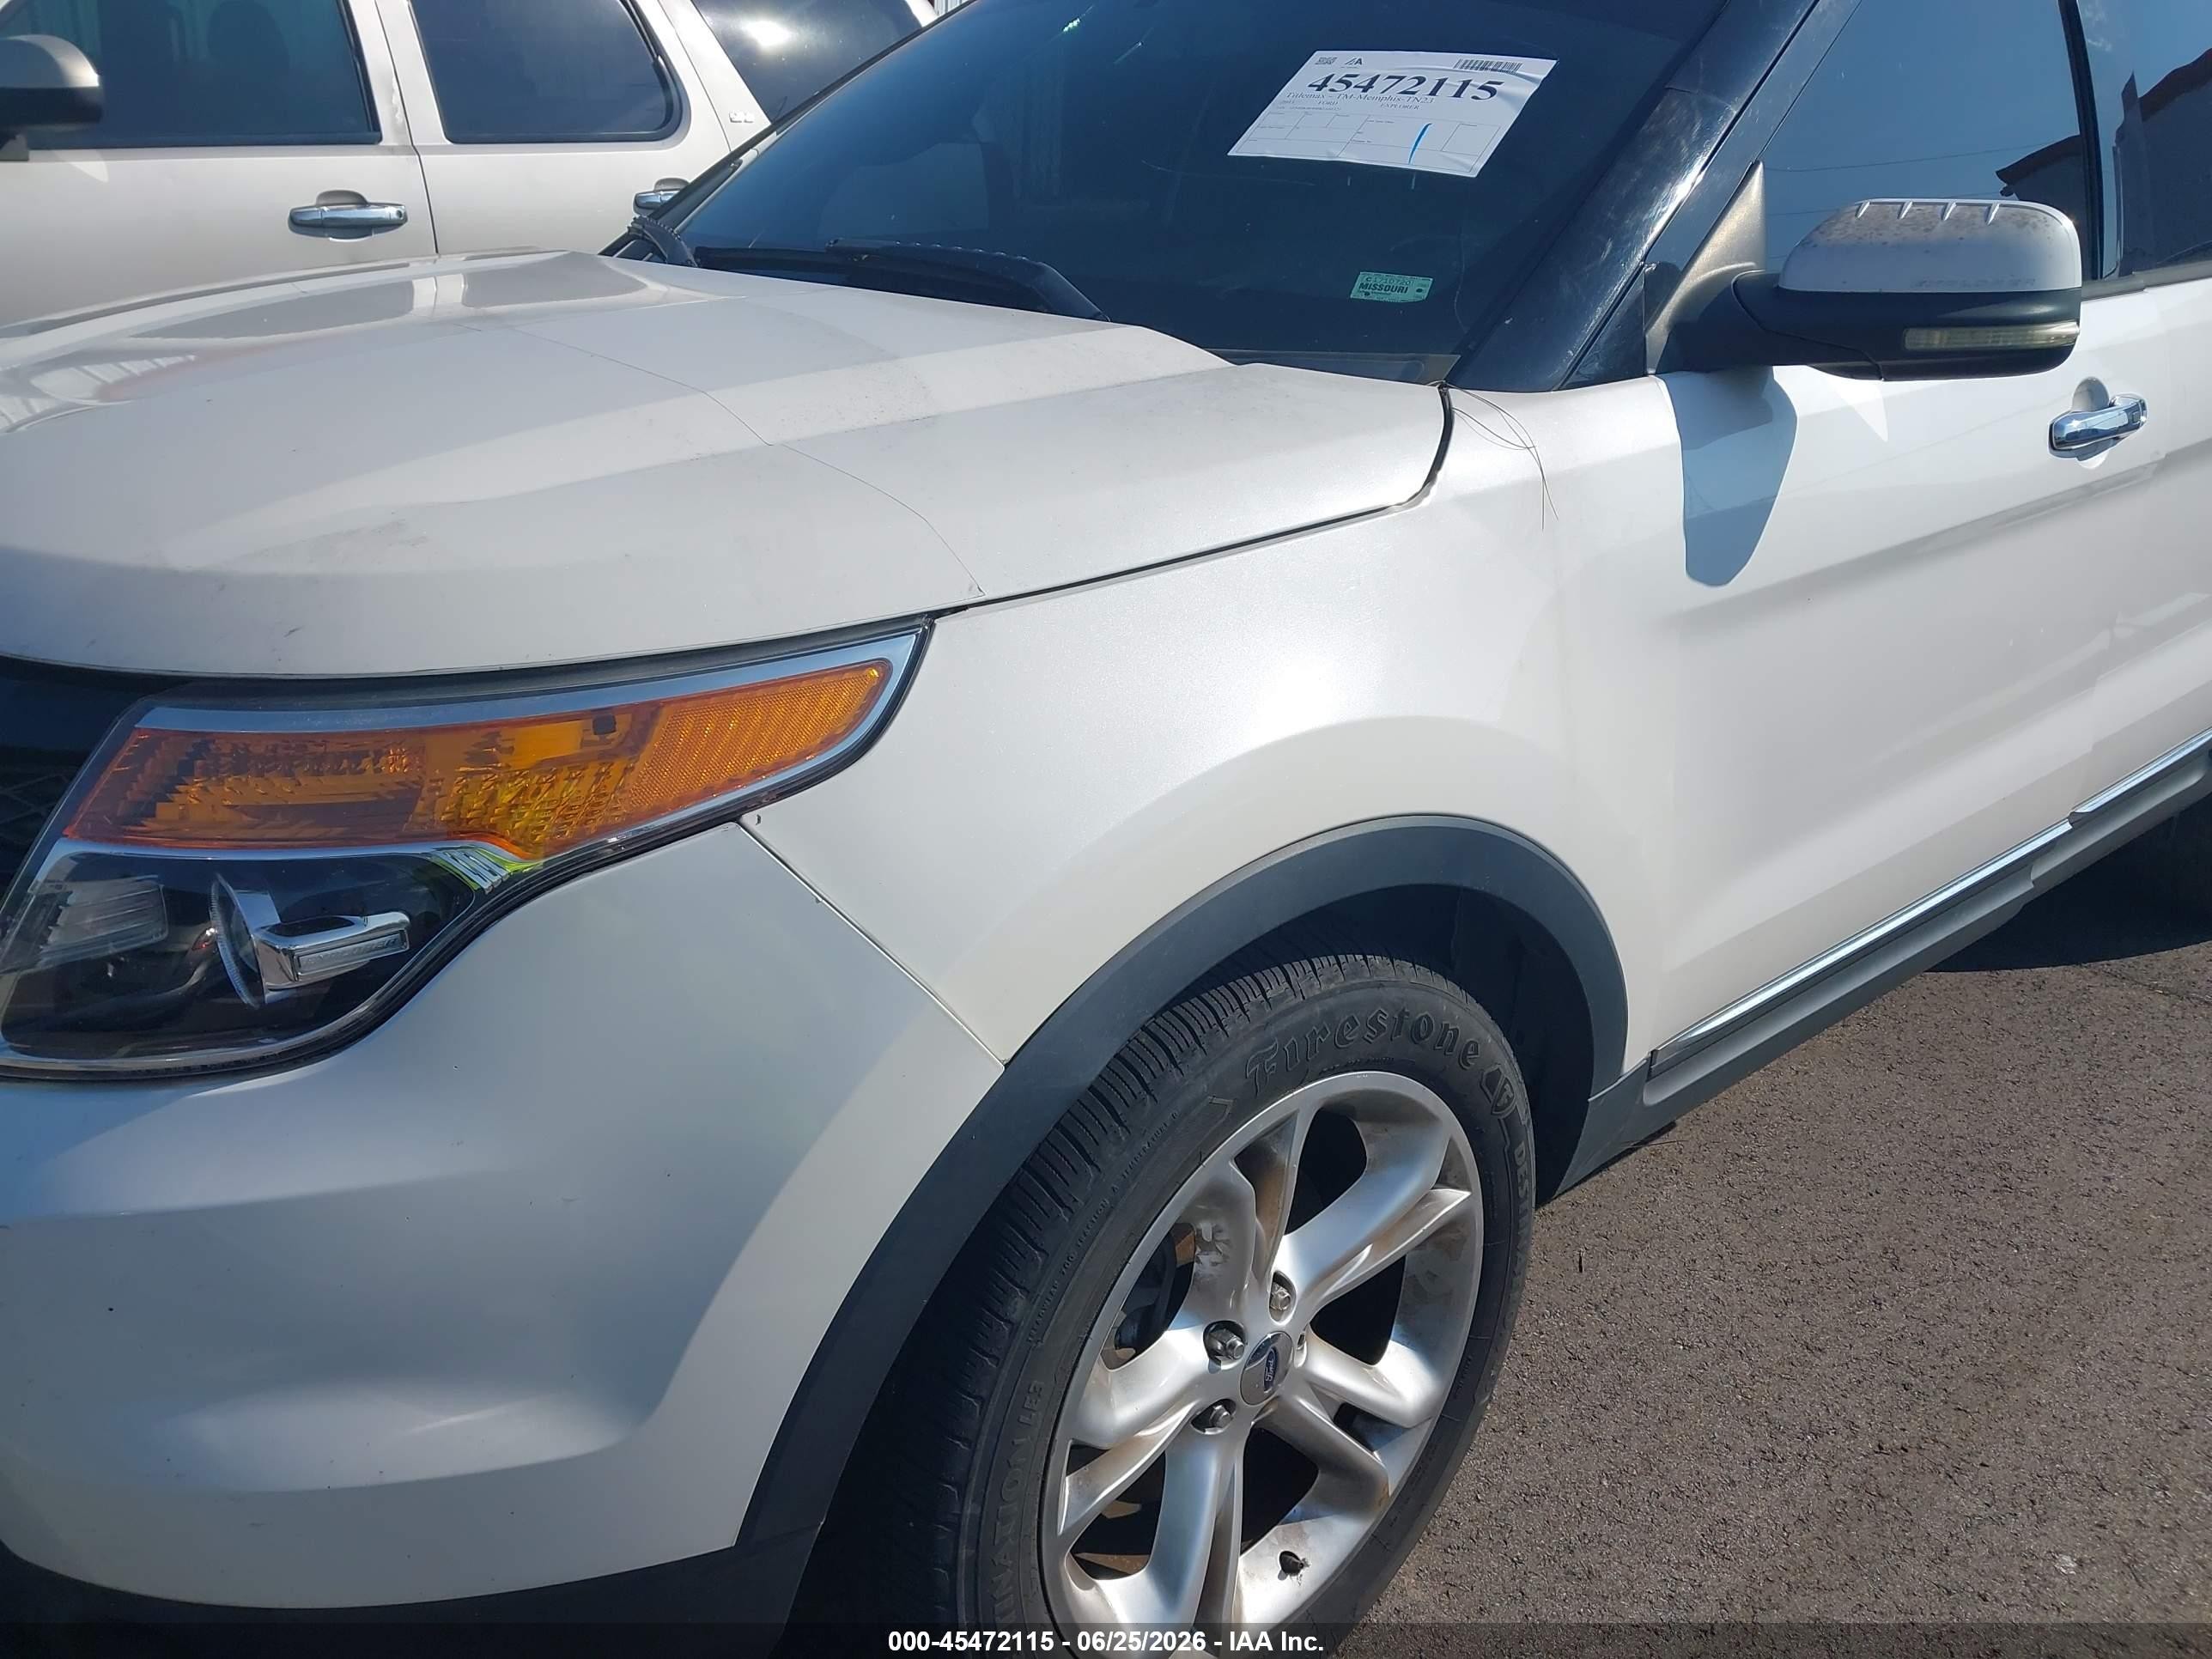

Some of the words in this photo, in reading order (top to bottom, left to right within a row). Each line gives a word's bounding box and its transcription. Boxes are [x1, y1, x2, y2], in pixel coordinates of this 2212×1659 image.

[1307, 73, 1504, 100] 45472115
[1358, 282, 1409, 294] MISSOURI
[1244, 1006, 1480, 1096] Firestone
